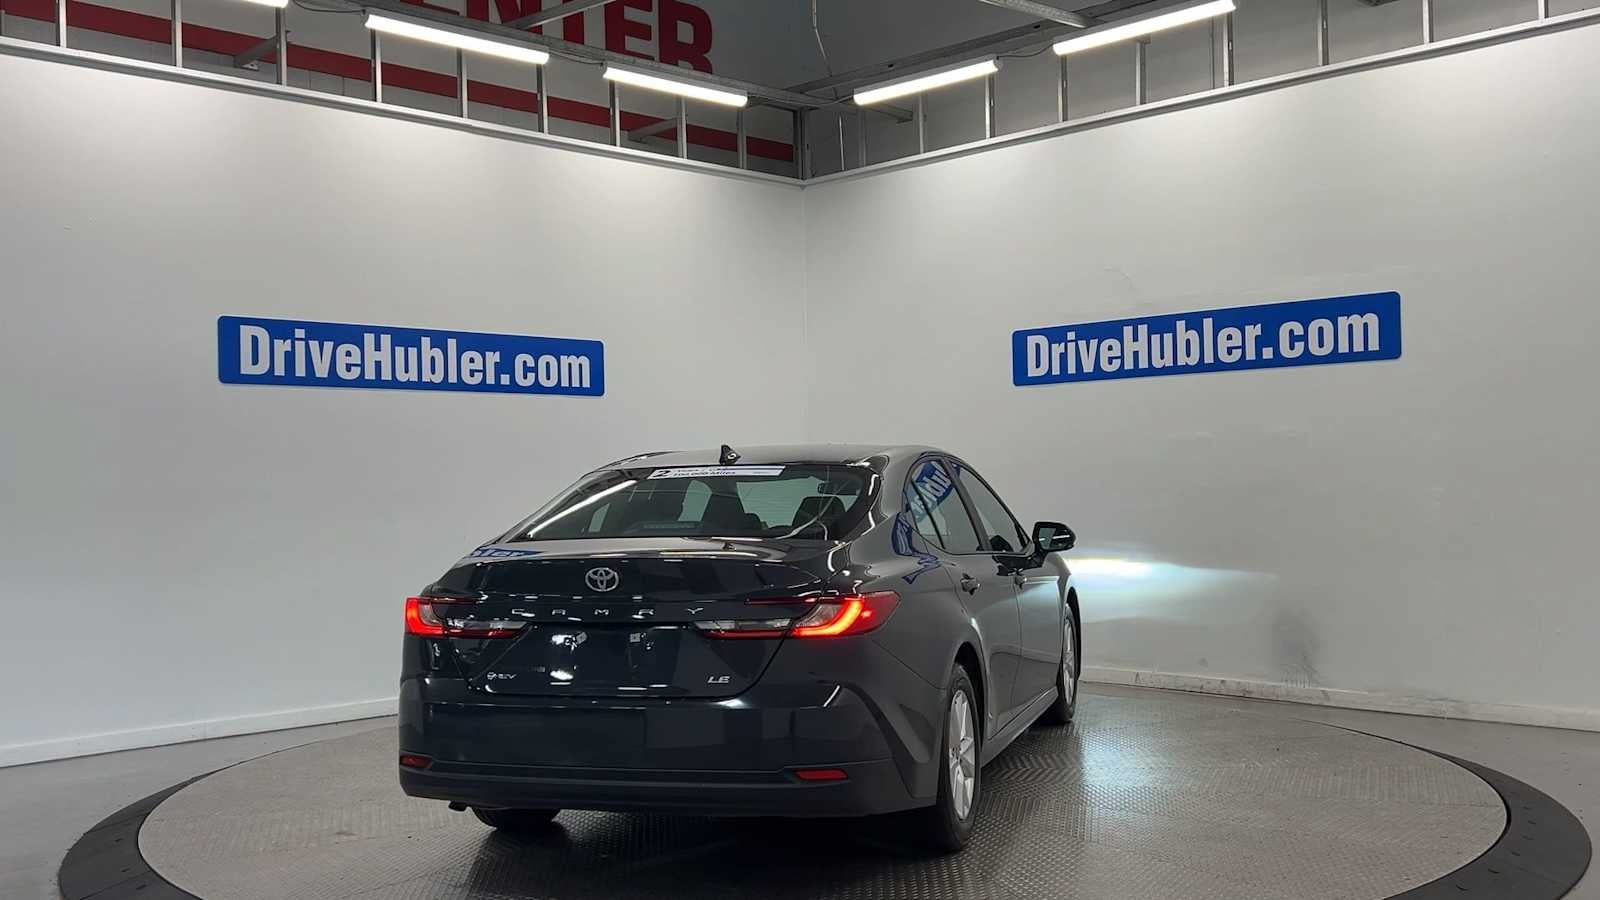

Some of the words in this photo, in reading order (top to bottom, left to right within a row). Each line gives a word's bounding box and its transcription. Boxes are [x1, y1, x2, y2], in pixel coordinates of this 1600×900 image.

[239, 324, 591, 389] DriveHubler.com
[1026, 311, 1380, 378] DriveHubler.com
[511, 607, 704, 616] CAMRY
[707, 676, 730, 684] LE
